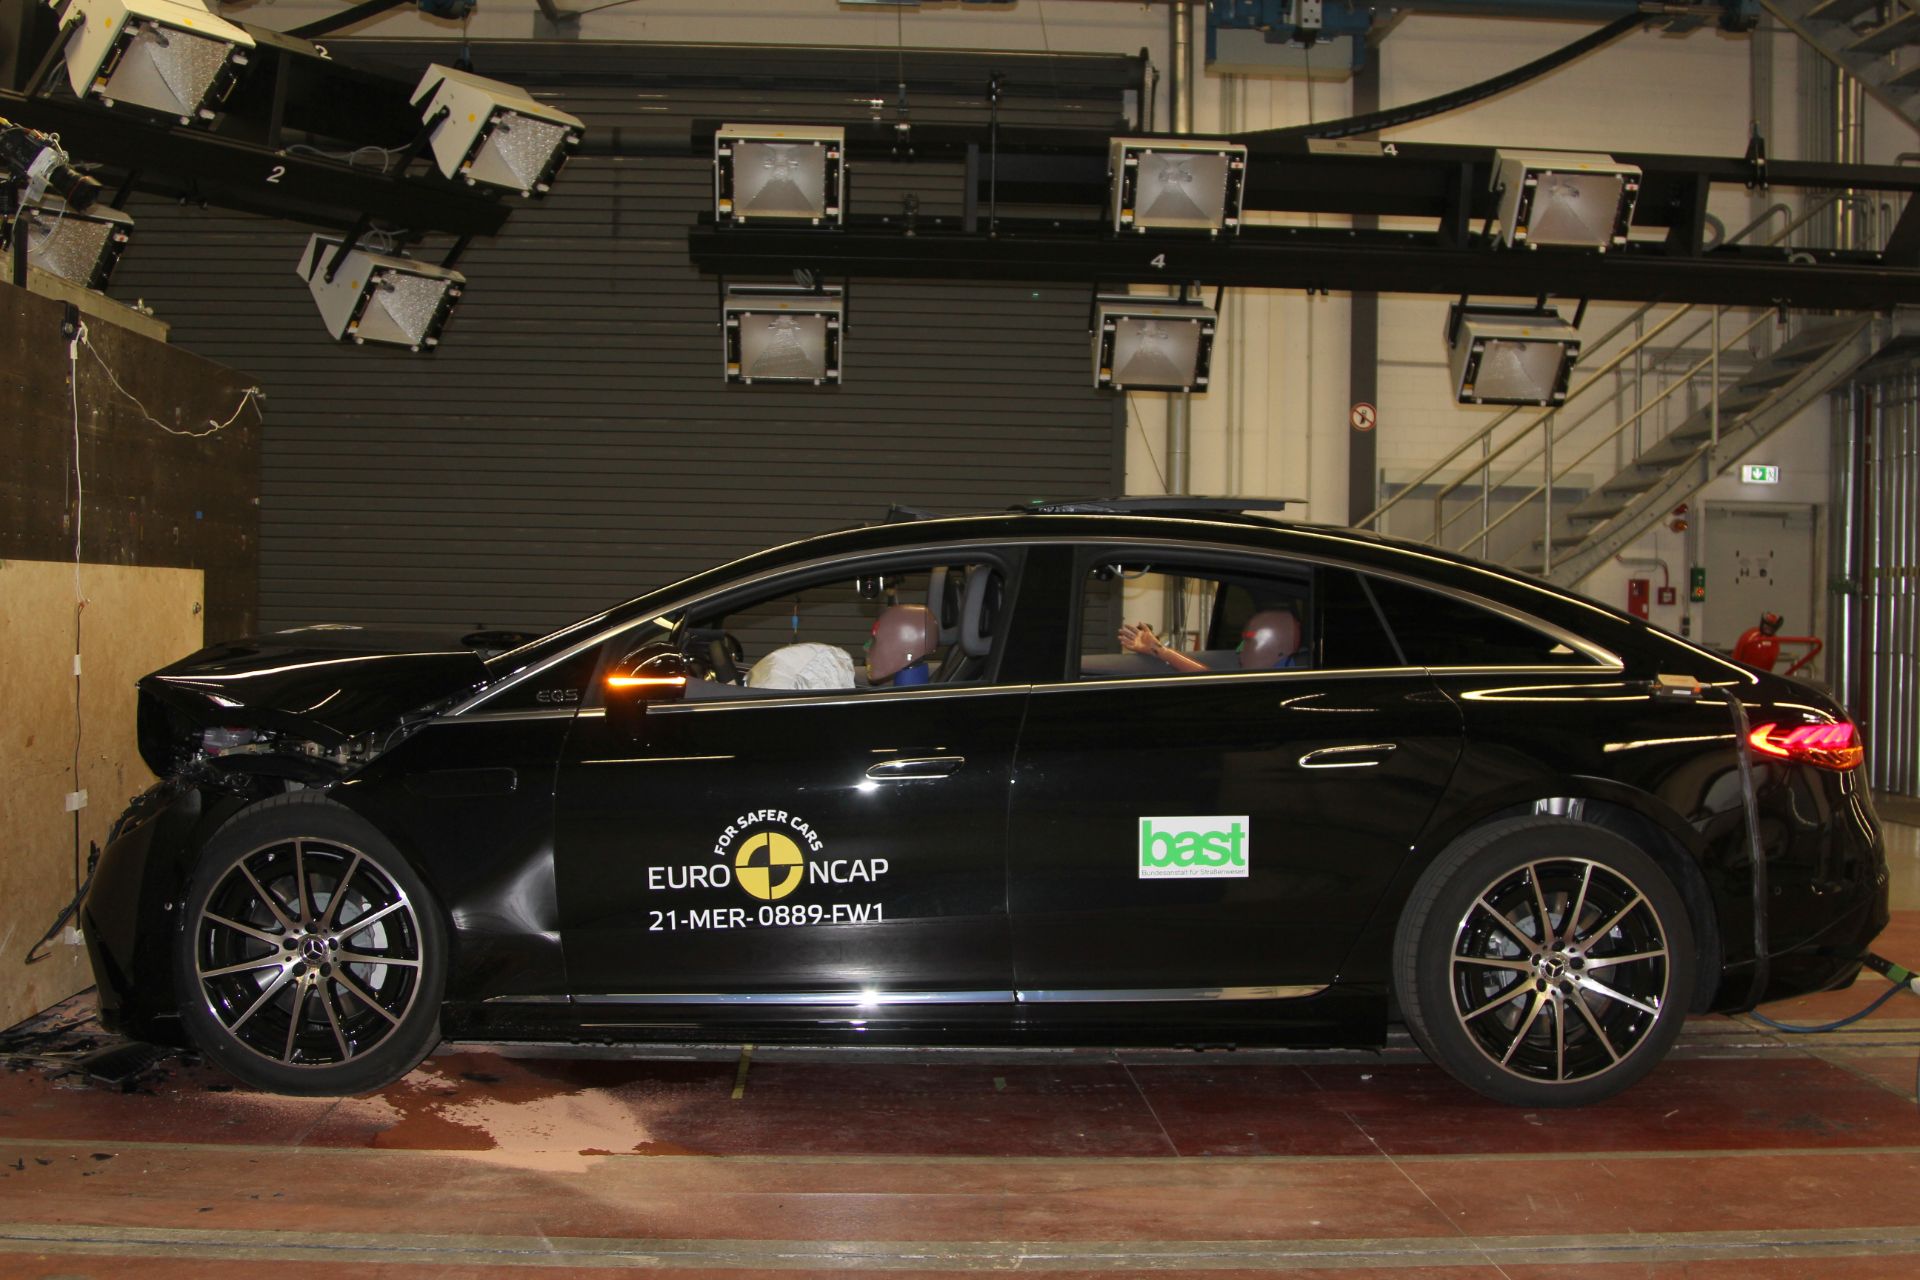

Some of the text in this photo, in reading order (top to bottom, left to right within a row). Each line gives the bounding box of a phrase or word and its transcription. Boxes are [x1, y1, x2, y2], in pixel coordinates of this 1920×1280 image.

[315, 44, 333, 60] 2
[1383, 143, 1399, 156] 4
[266, 165, 286, 183] 2
[1150, 253, 1166, 269] 4
[536, 688, 579, 702] EQS
[714, 809, 824, 856] FOR SAFER CARS
[1142, 820, 1246, 867] bast
[648, 858, 889, 890] EURO NCAP
